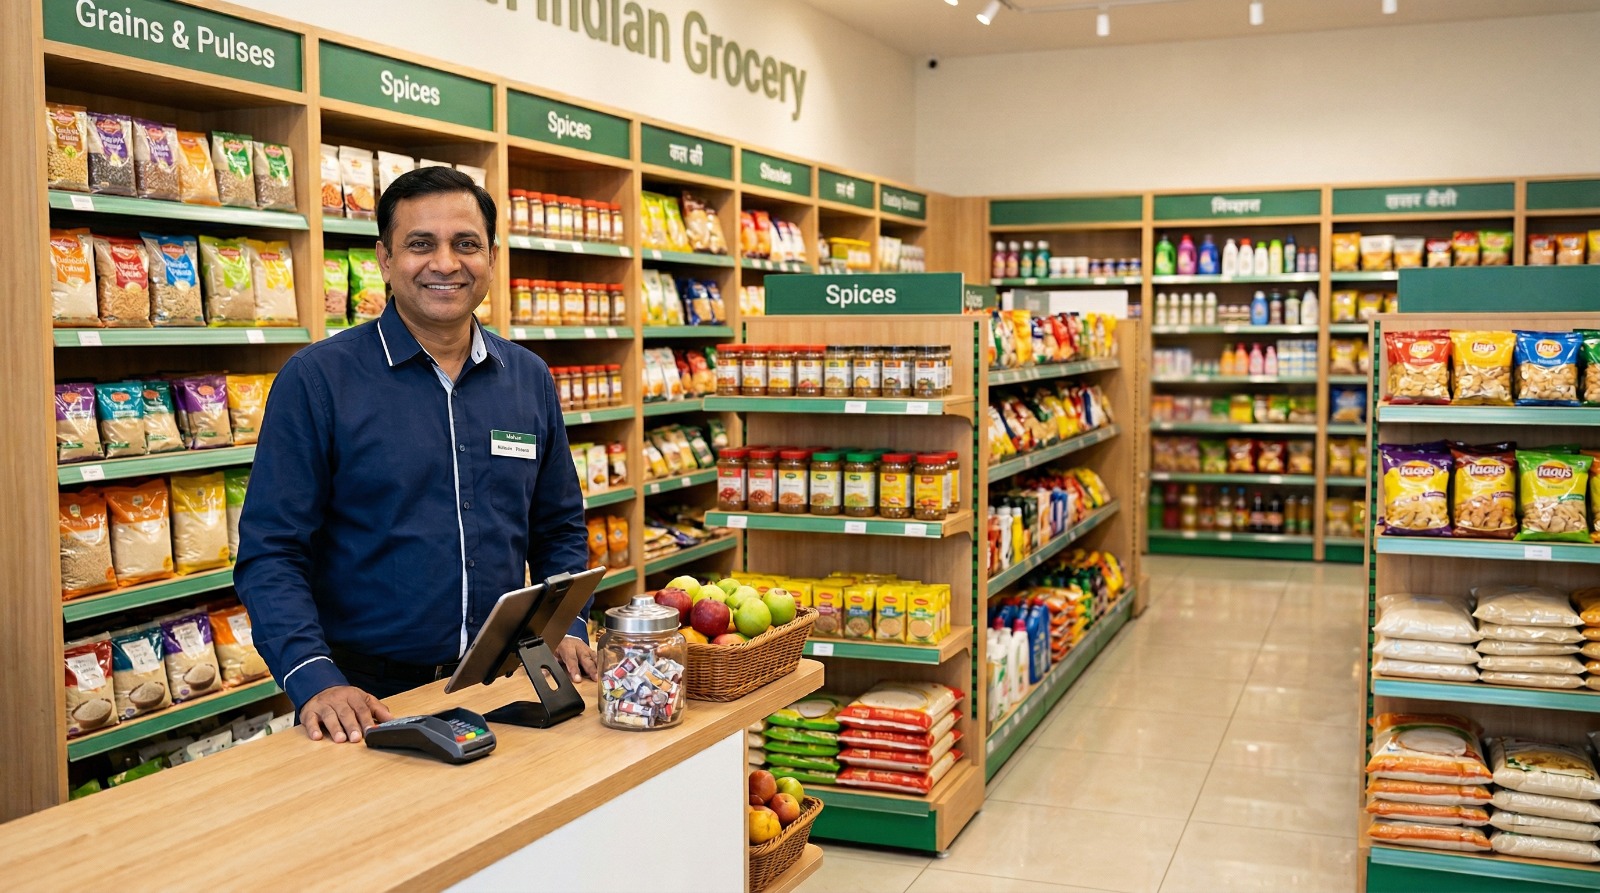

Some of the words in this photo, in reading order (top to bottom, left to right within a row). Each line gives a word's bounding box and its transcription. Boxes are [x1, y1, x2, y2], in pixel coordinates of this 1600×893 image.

[75, 0, 164, 44] Grains
[171, 20, 190, 50] &
[197, 25, 275, 69] Pulses
[683, 10, 807, 122] Grocery
[380, 69, 441, 106] Spices
[547, 110, 592, 141] Spices
[825, 283, 897, 309] Spices
